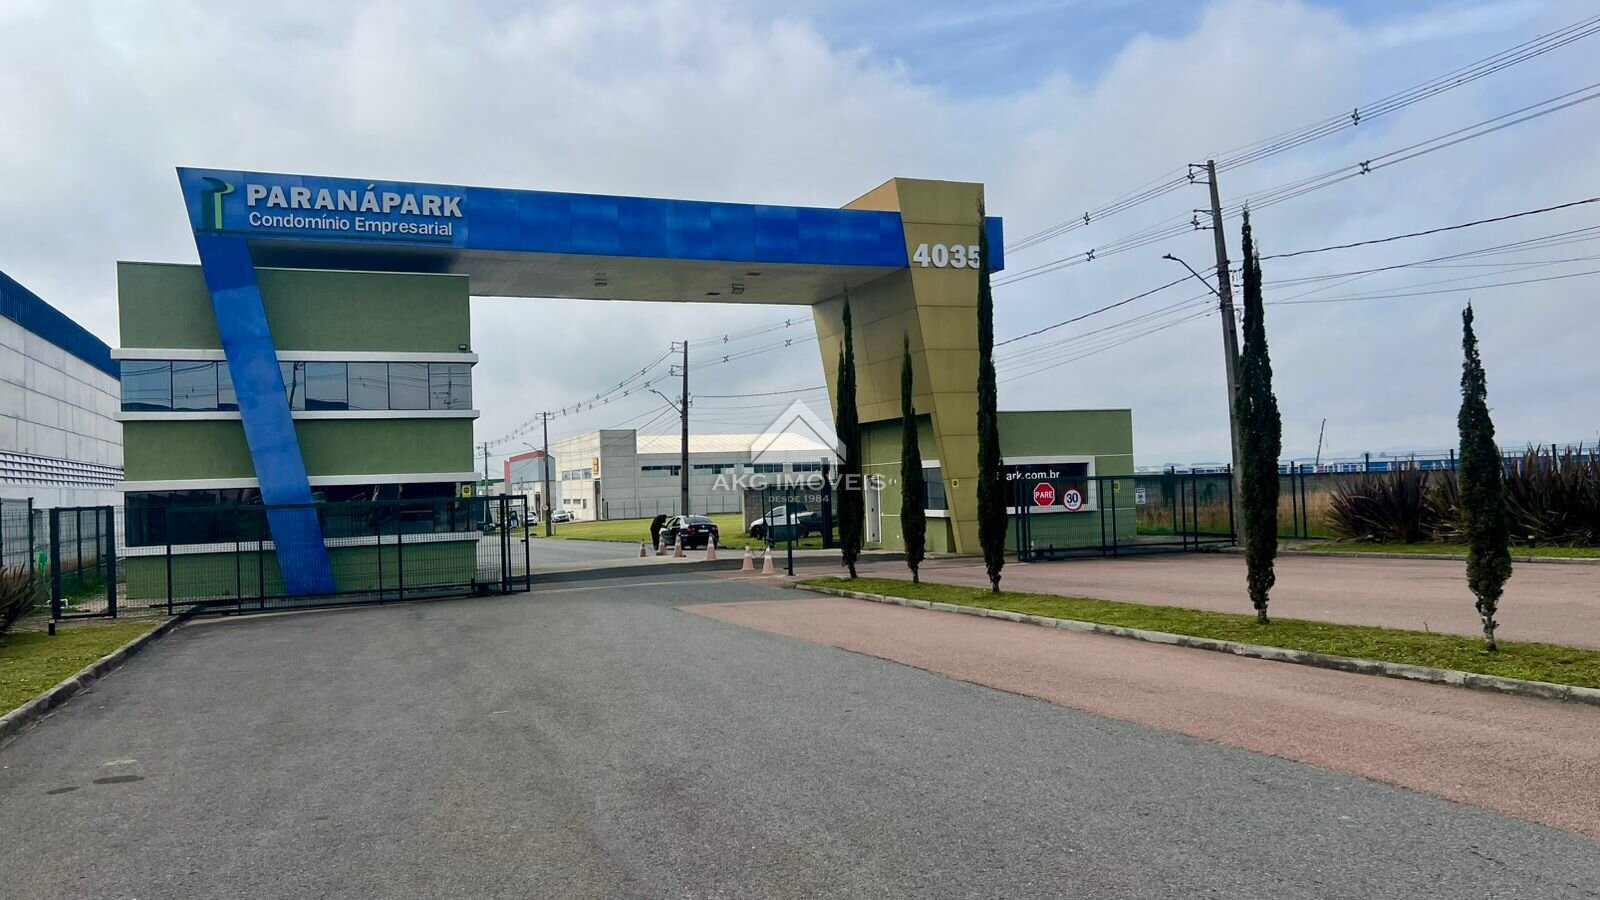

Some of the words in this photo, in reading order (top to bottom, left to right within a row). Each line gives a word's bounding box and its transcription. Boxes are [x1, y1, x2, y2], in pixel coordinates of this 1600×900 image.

[246, 184, 463, 218] PARANÁPARK
[249, 211, 351, 231] Condomínio
[355, 217, 453, 236] Empresarial
[913, 243, 980, 269] 4035
[1006, 470, 1060, 481] ark.com.br
[1035, 491, 1054, 499] PARE
[1066, 492, 1079, 504] 30
